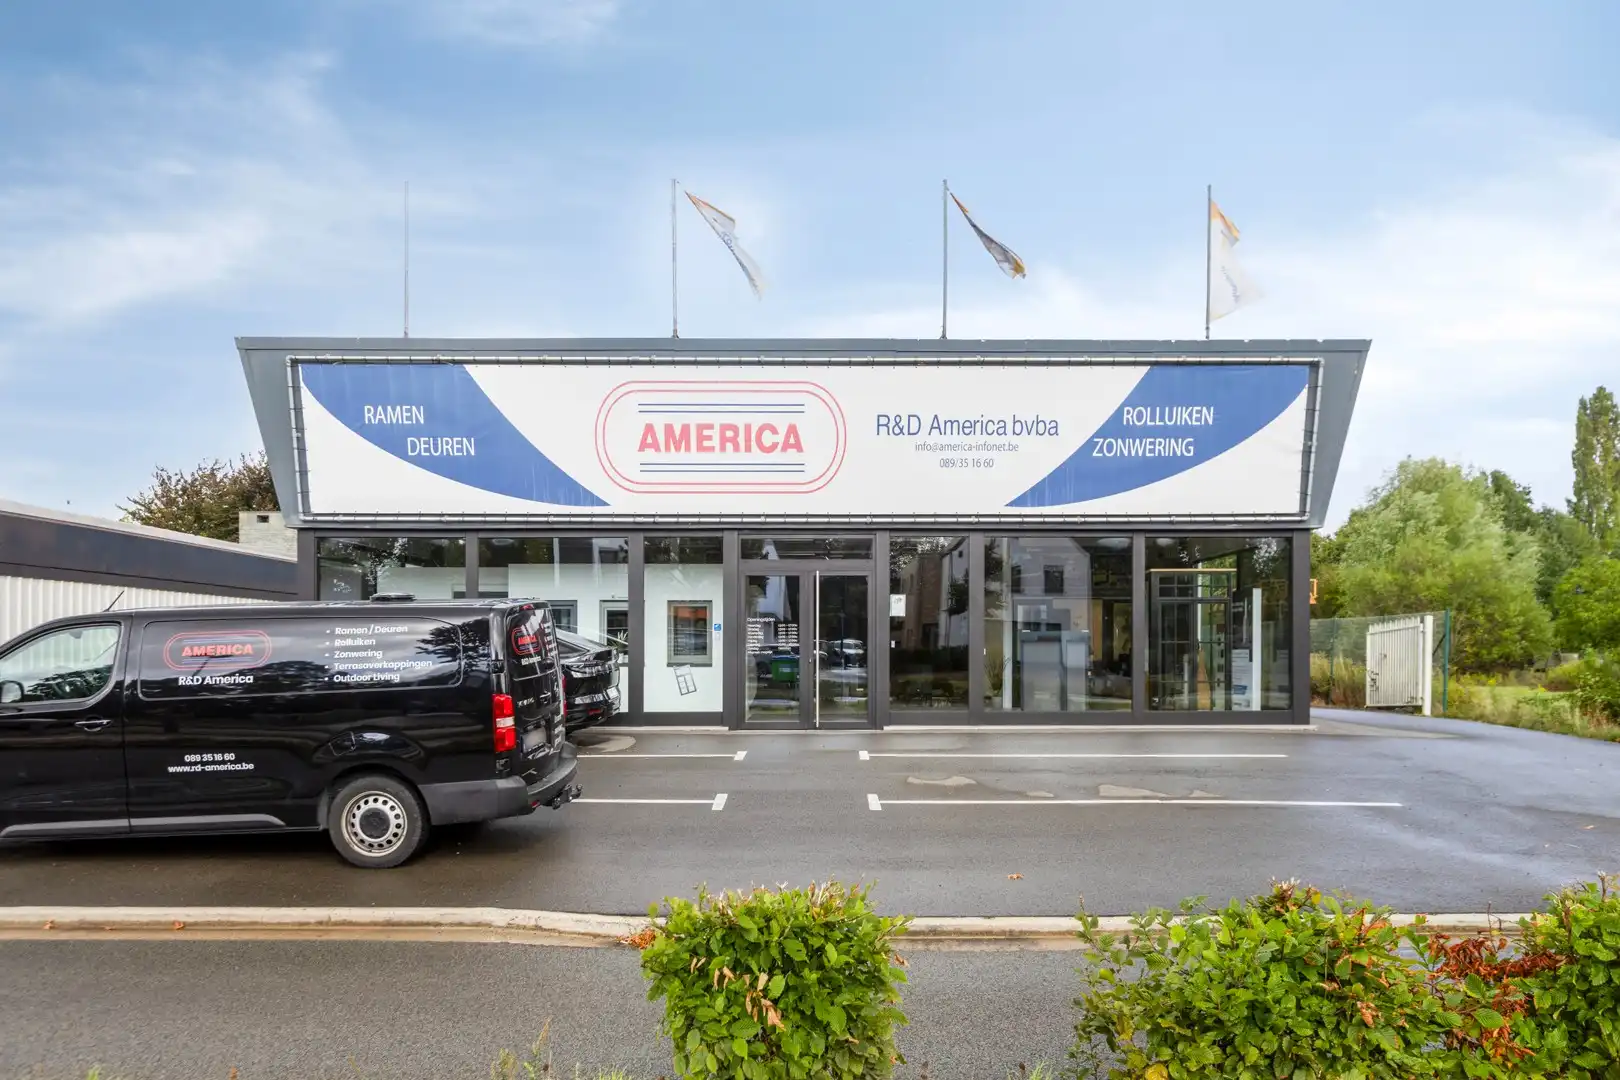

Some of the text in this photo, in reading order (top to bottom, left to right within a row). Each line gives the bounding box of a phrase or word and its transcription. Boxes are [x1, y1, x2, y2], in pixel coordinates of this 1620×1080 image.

[363, 405, 425, 425] RAMEN
[1123, 406, 1214, 427] ROLLUIKEN
[875, 414, 1060, 437] R&D America bvba
[637, 422, 805, 454] AMERICA
[407, 437, 475, 456] DEUREN
[914, 441, 1019, 454] info@america-infonet.be
[1092, 438, 1195, 458] ZONWERING
[939, 458, 994, 469] 089/35 16 60
[335, 627, 368, 635] Ramen
[374, 625, 408, 634] Deuren
[334, 637, 376, 647] Rolluiken
[181, 643, 254, 657] AMERICA
[333, 649, 383, 659] Zonwering
[333, 660, 433, 671] Terrasoverkappingen
[178, 673, 254, 686] R&D America
[333, 672, 400, 682] Outdoor Living
[184, 754, 201, 762] 089
[202, 753, 213, 761] 35
[224, 752, 236, 761] 60
[167, 762, 255, 773] www.rd-america.be
